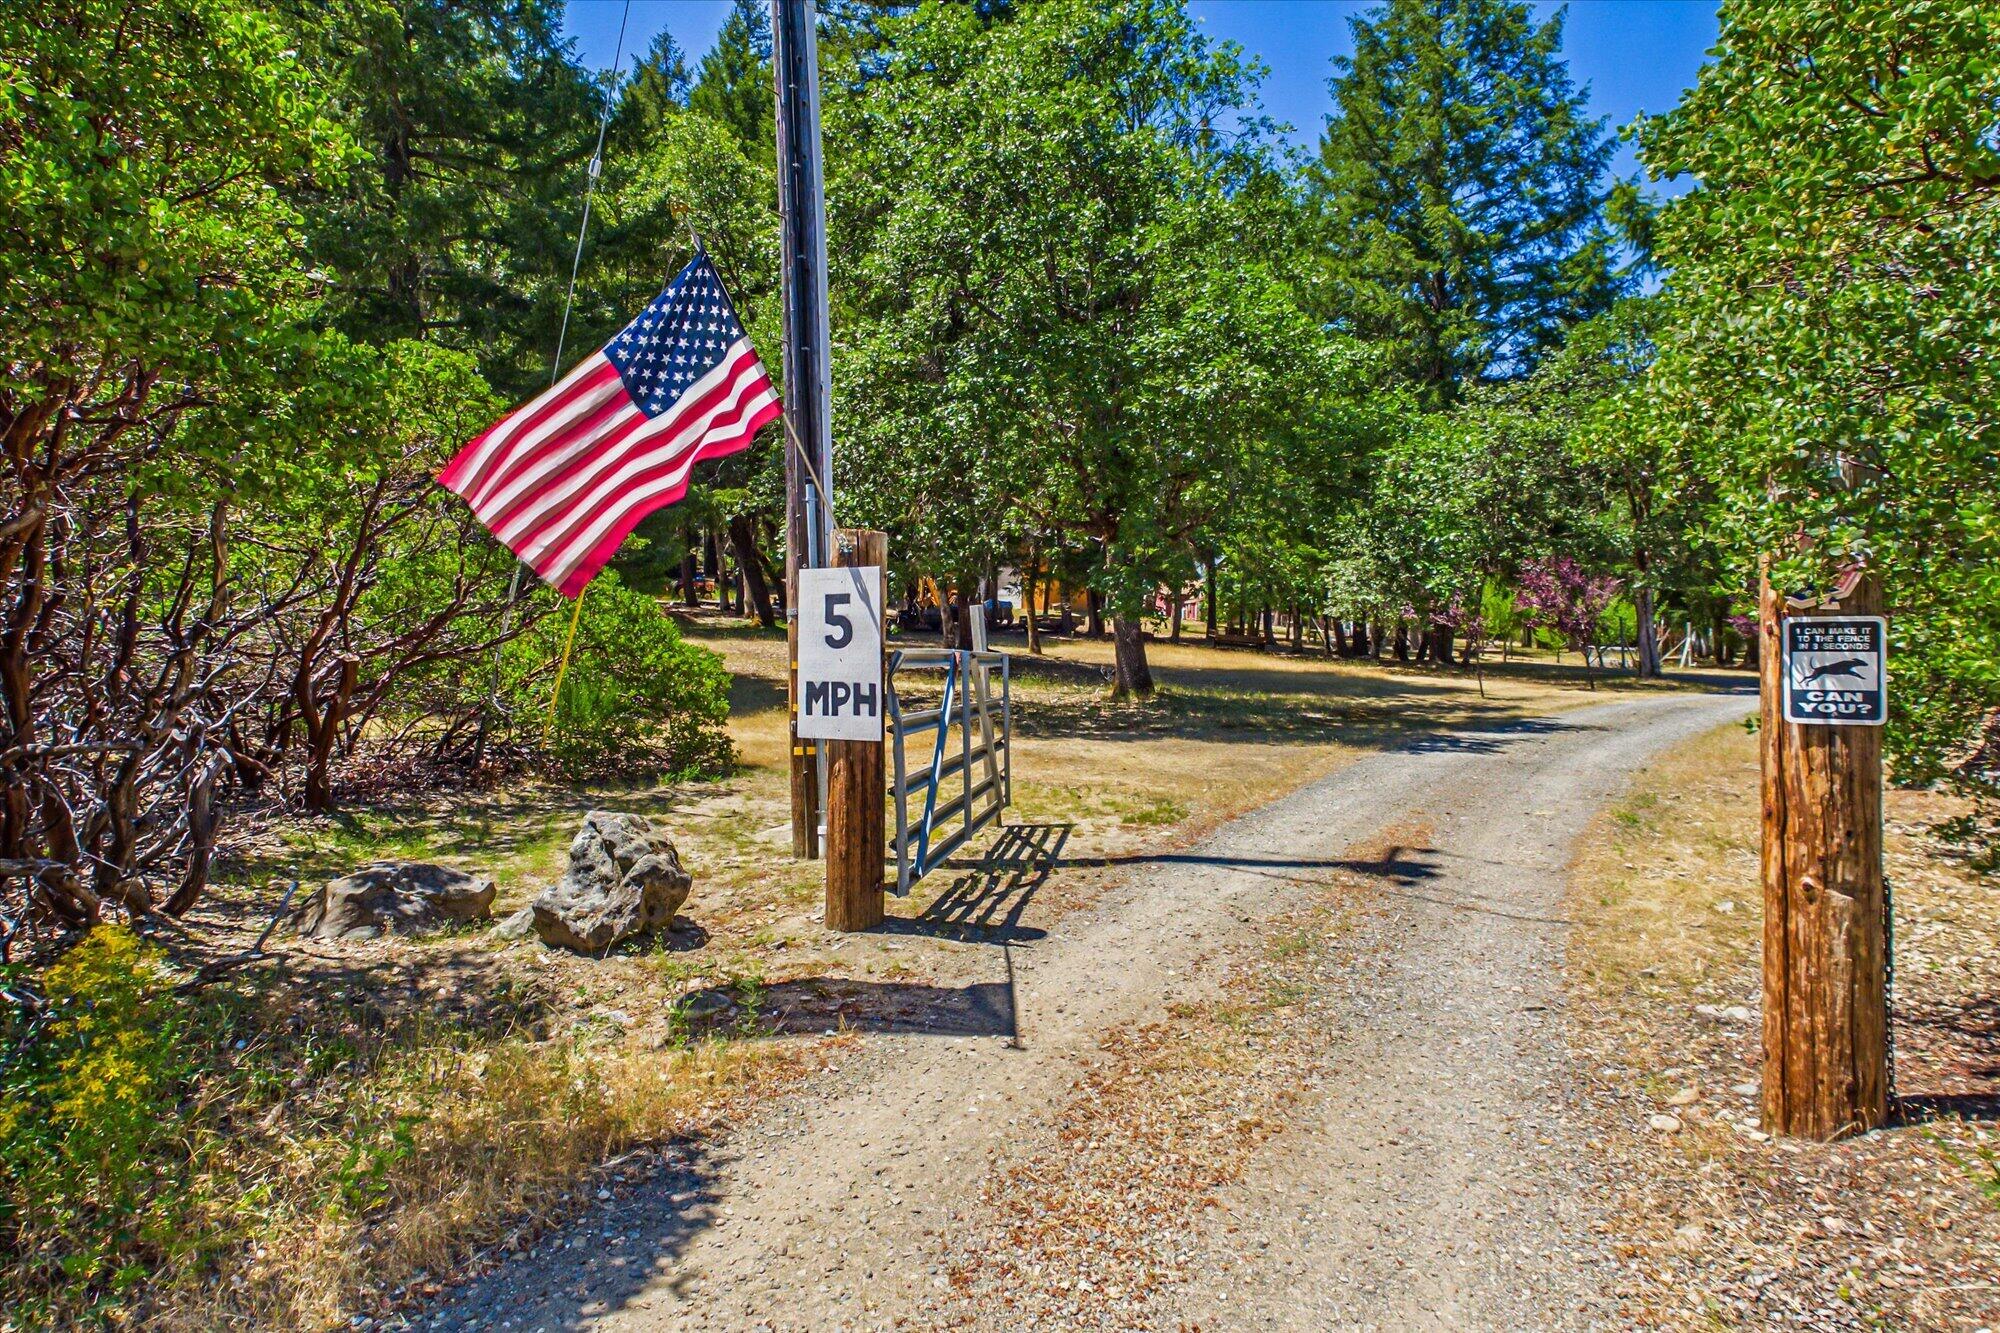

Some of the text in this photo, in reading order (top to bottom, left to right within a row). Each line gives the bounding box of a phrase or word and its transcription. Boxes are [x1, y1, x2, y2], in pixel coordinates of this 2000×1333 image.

[825, 593, 853, 649] 5
[1862, 627, 1871, 635] IT
[805, 681, 877, 717] MPH
[1807, 692, 1863, 702] CAN
[1798, 703, 1872, 714] YOU?
